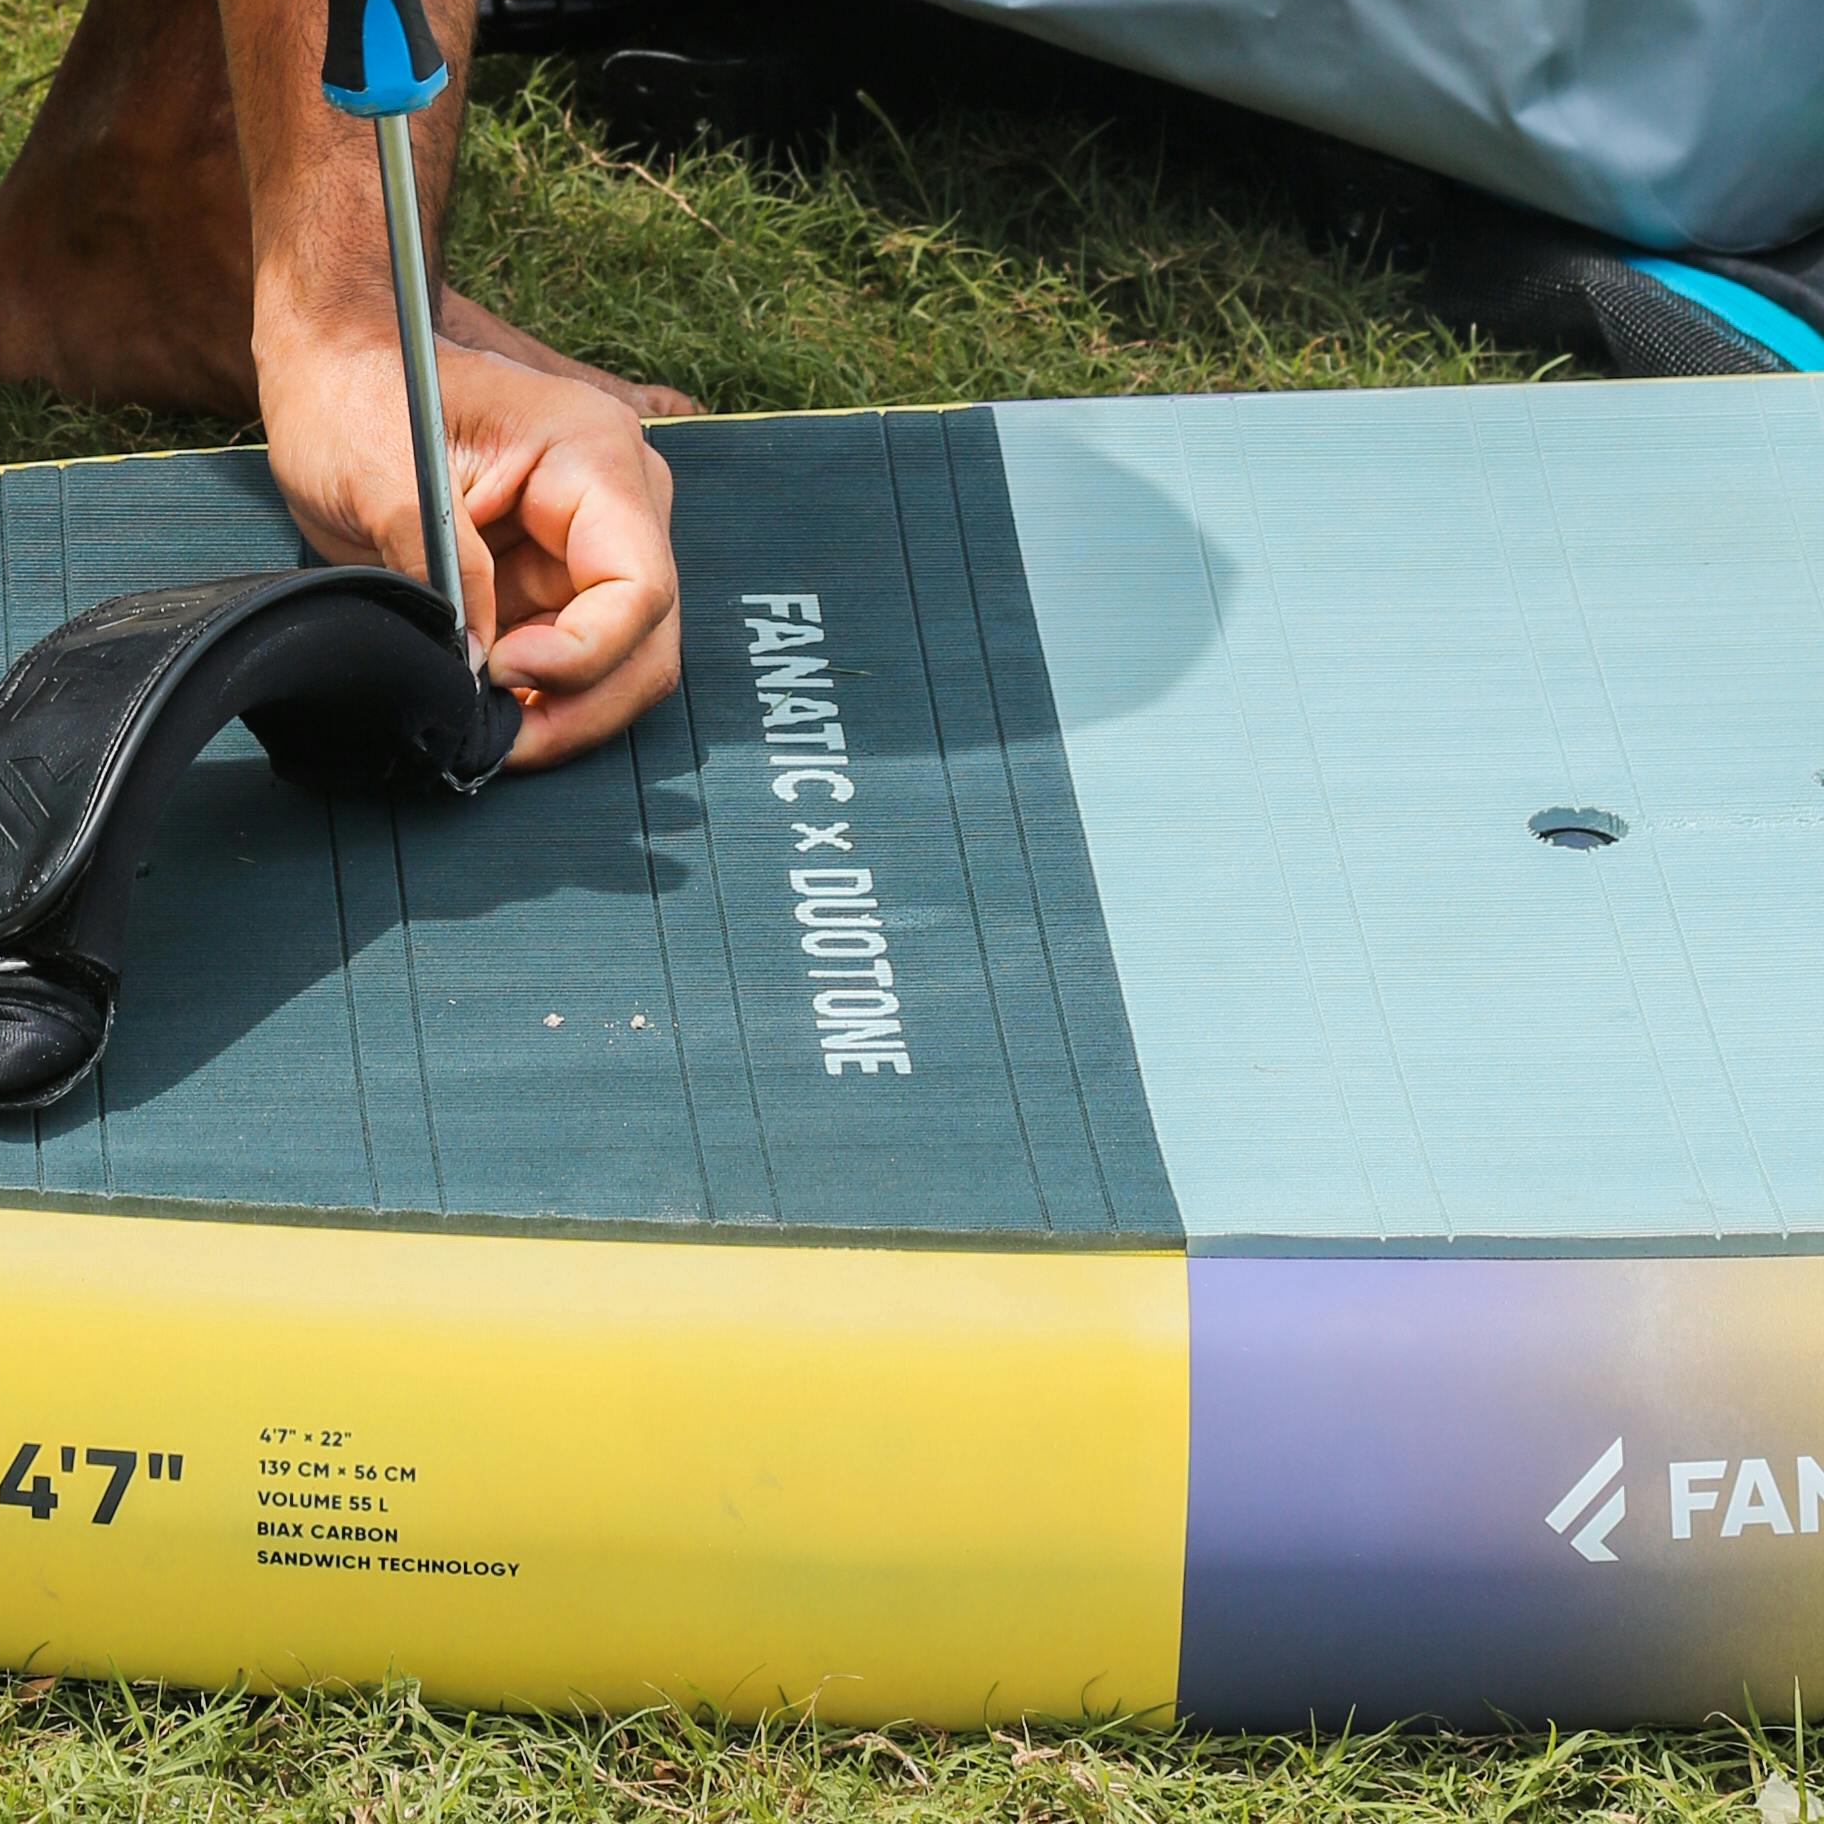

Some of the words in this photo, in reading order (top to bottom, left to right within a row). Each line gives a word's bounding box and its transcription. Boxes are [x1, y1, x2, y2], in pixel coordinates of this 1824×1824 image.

[741, 594, 855, 803] FANATIC
[789, 868, 913, 1076] DUOTONE
[259, 1428, 297, 1444] 4'7"
[321, 1431, 353, 1447] 22"
[258, 1459, 291, 1477] 139
[298, 1462, 330, 1478] CM
[354, 1465, 377, 1480] 56
[384, 1467, 416, 1482] CM
[258, 1491, 342, 1511] VOLUME
[349, 1496, 372, 1511] 55
[379, 1497, 389, 1513] L
[257, 1521, 304, 1539] BIAX
[311, 1525, 398, 1543] CARBON
[257, 1550, 371, 1570] SANDWICH
[378, 1557, 520, 1577] TECHNOLOGY
